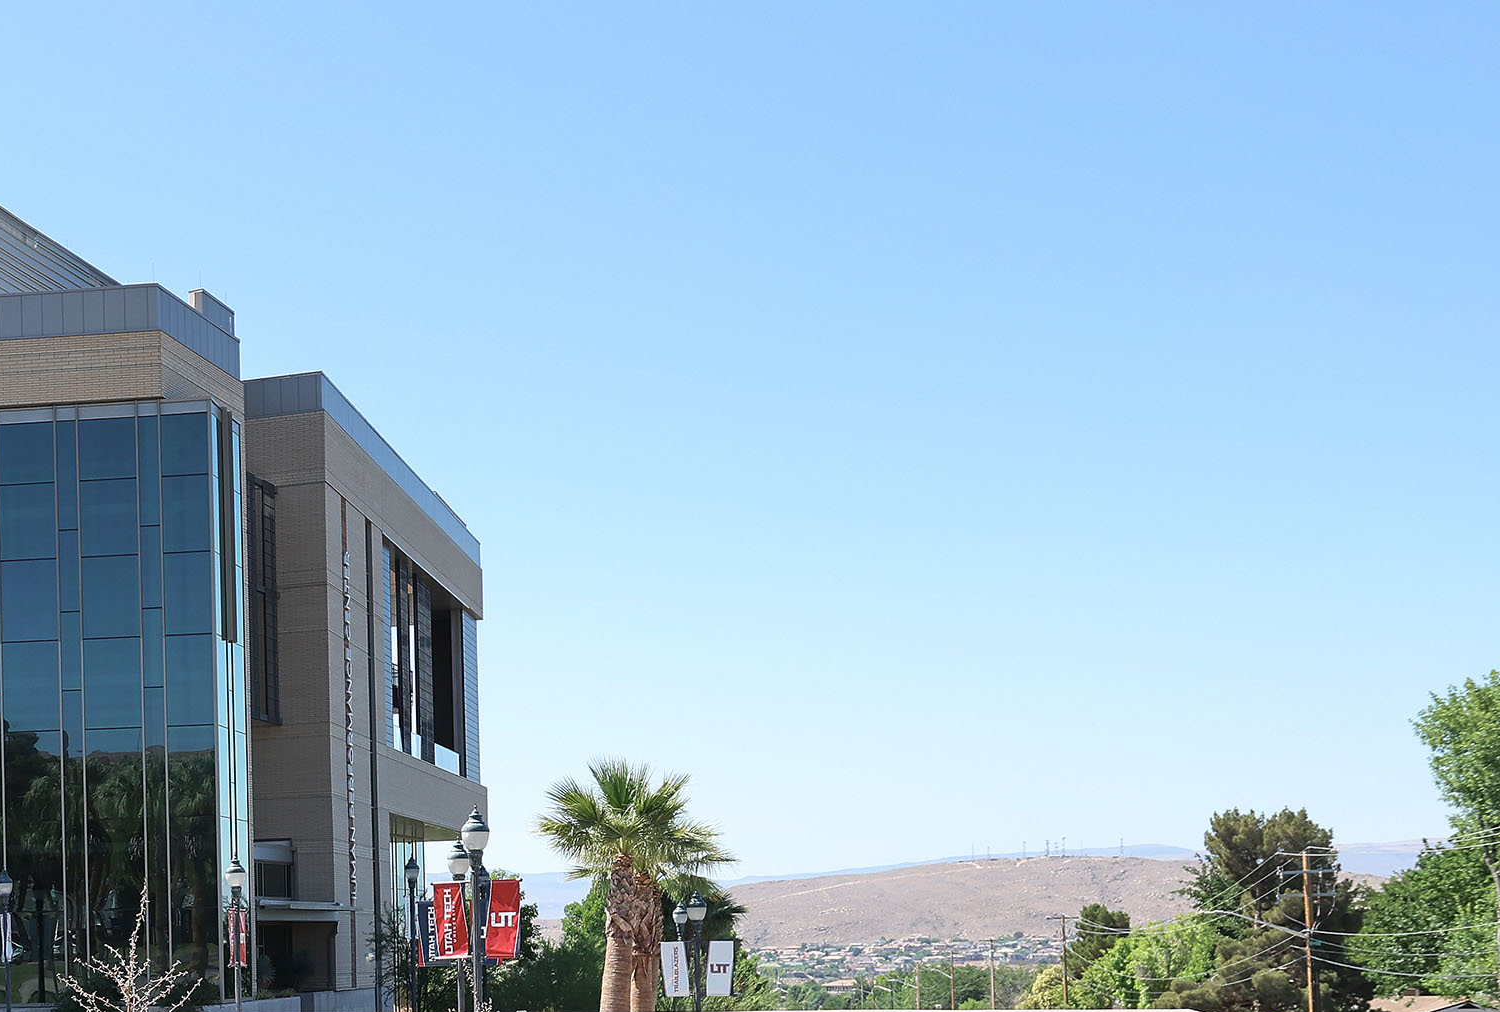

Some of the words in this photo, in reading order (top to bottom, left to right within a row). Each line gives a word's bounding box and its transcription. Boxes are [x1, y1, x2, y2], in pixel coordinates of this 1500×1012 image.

[443, 889, 452, 921] TECH
[490, 911, 516, 928] UT
[443, 923, 454, 954] UTAH
